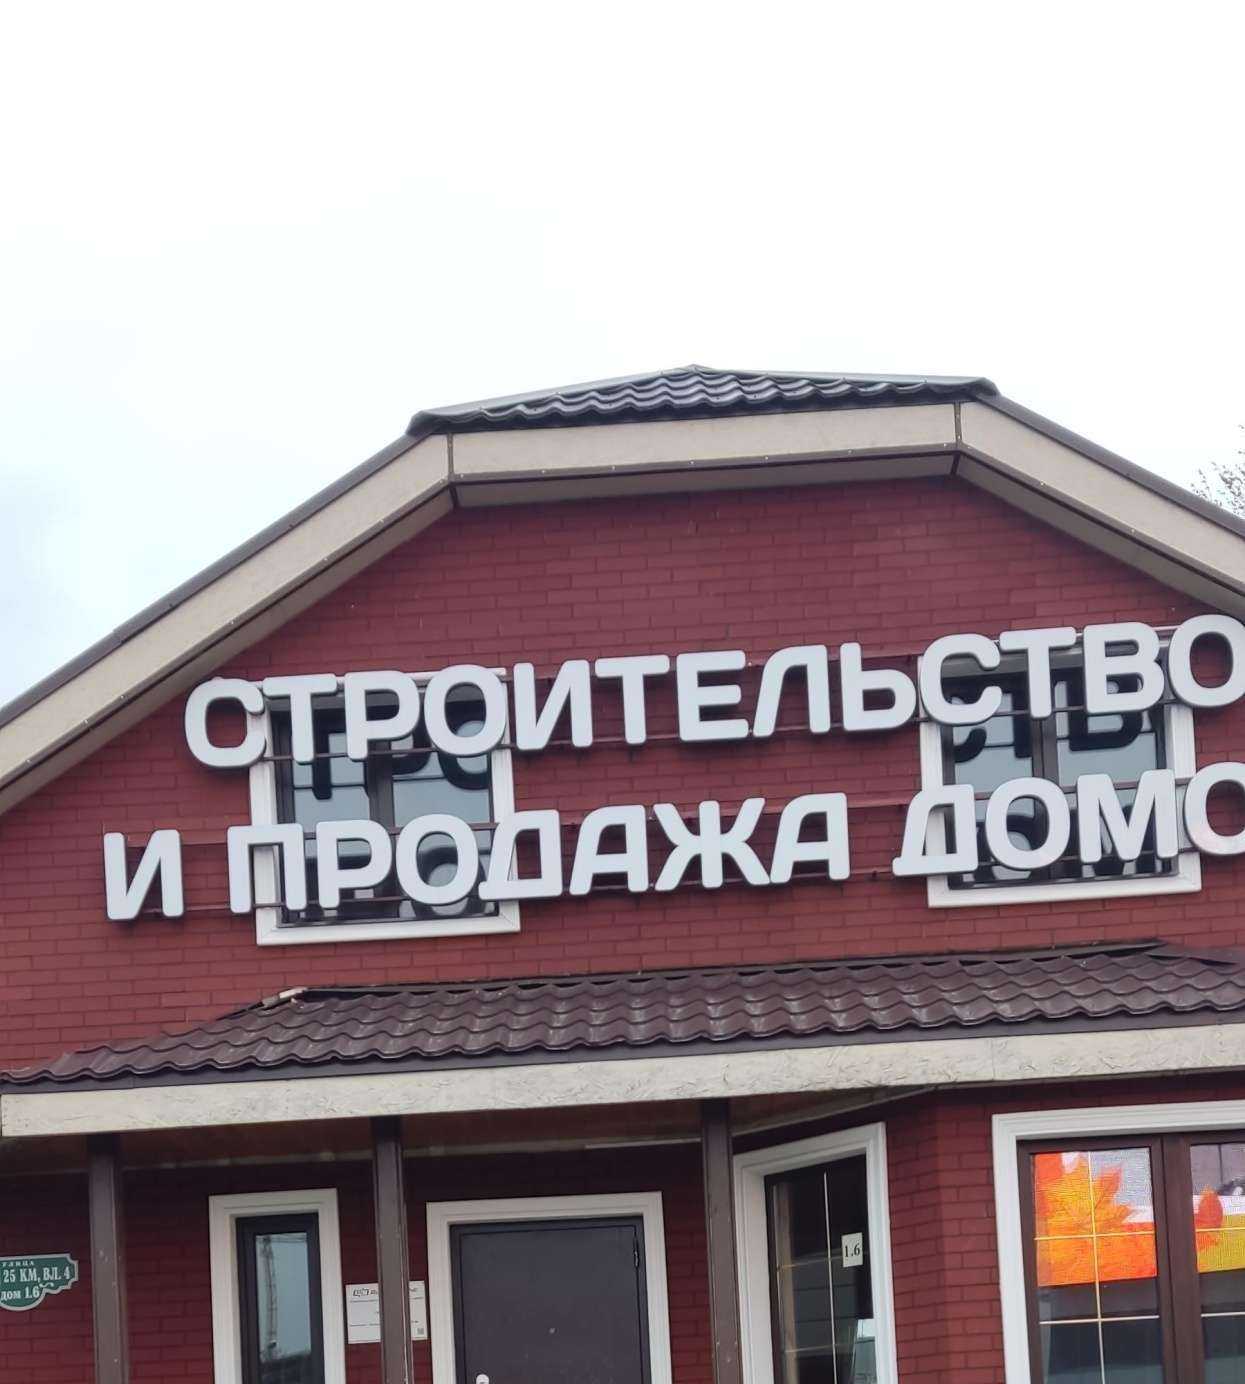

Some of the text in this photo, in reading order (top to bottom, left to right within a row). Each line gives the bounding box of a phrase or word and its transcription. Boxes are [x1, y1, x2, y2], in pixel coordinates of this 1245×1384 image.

[184, 614, 1245, 768] СТРОИТЕЛЬСТВО
[103, 762, 1245, 920] И ПРОДАЖА ДОМО
[844, 1242, 861, 1258] 1.6
[3, 1269, 16, 1282] 25
[19, 1267, 41, 1283] КМ,
[64, 1266, 70, 1280] 4
[24, 1285, 40, 1299] 1.6
